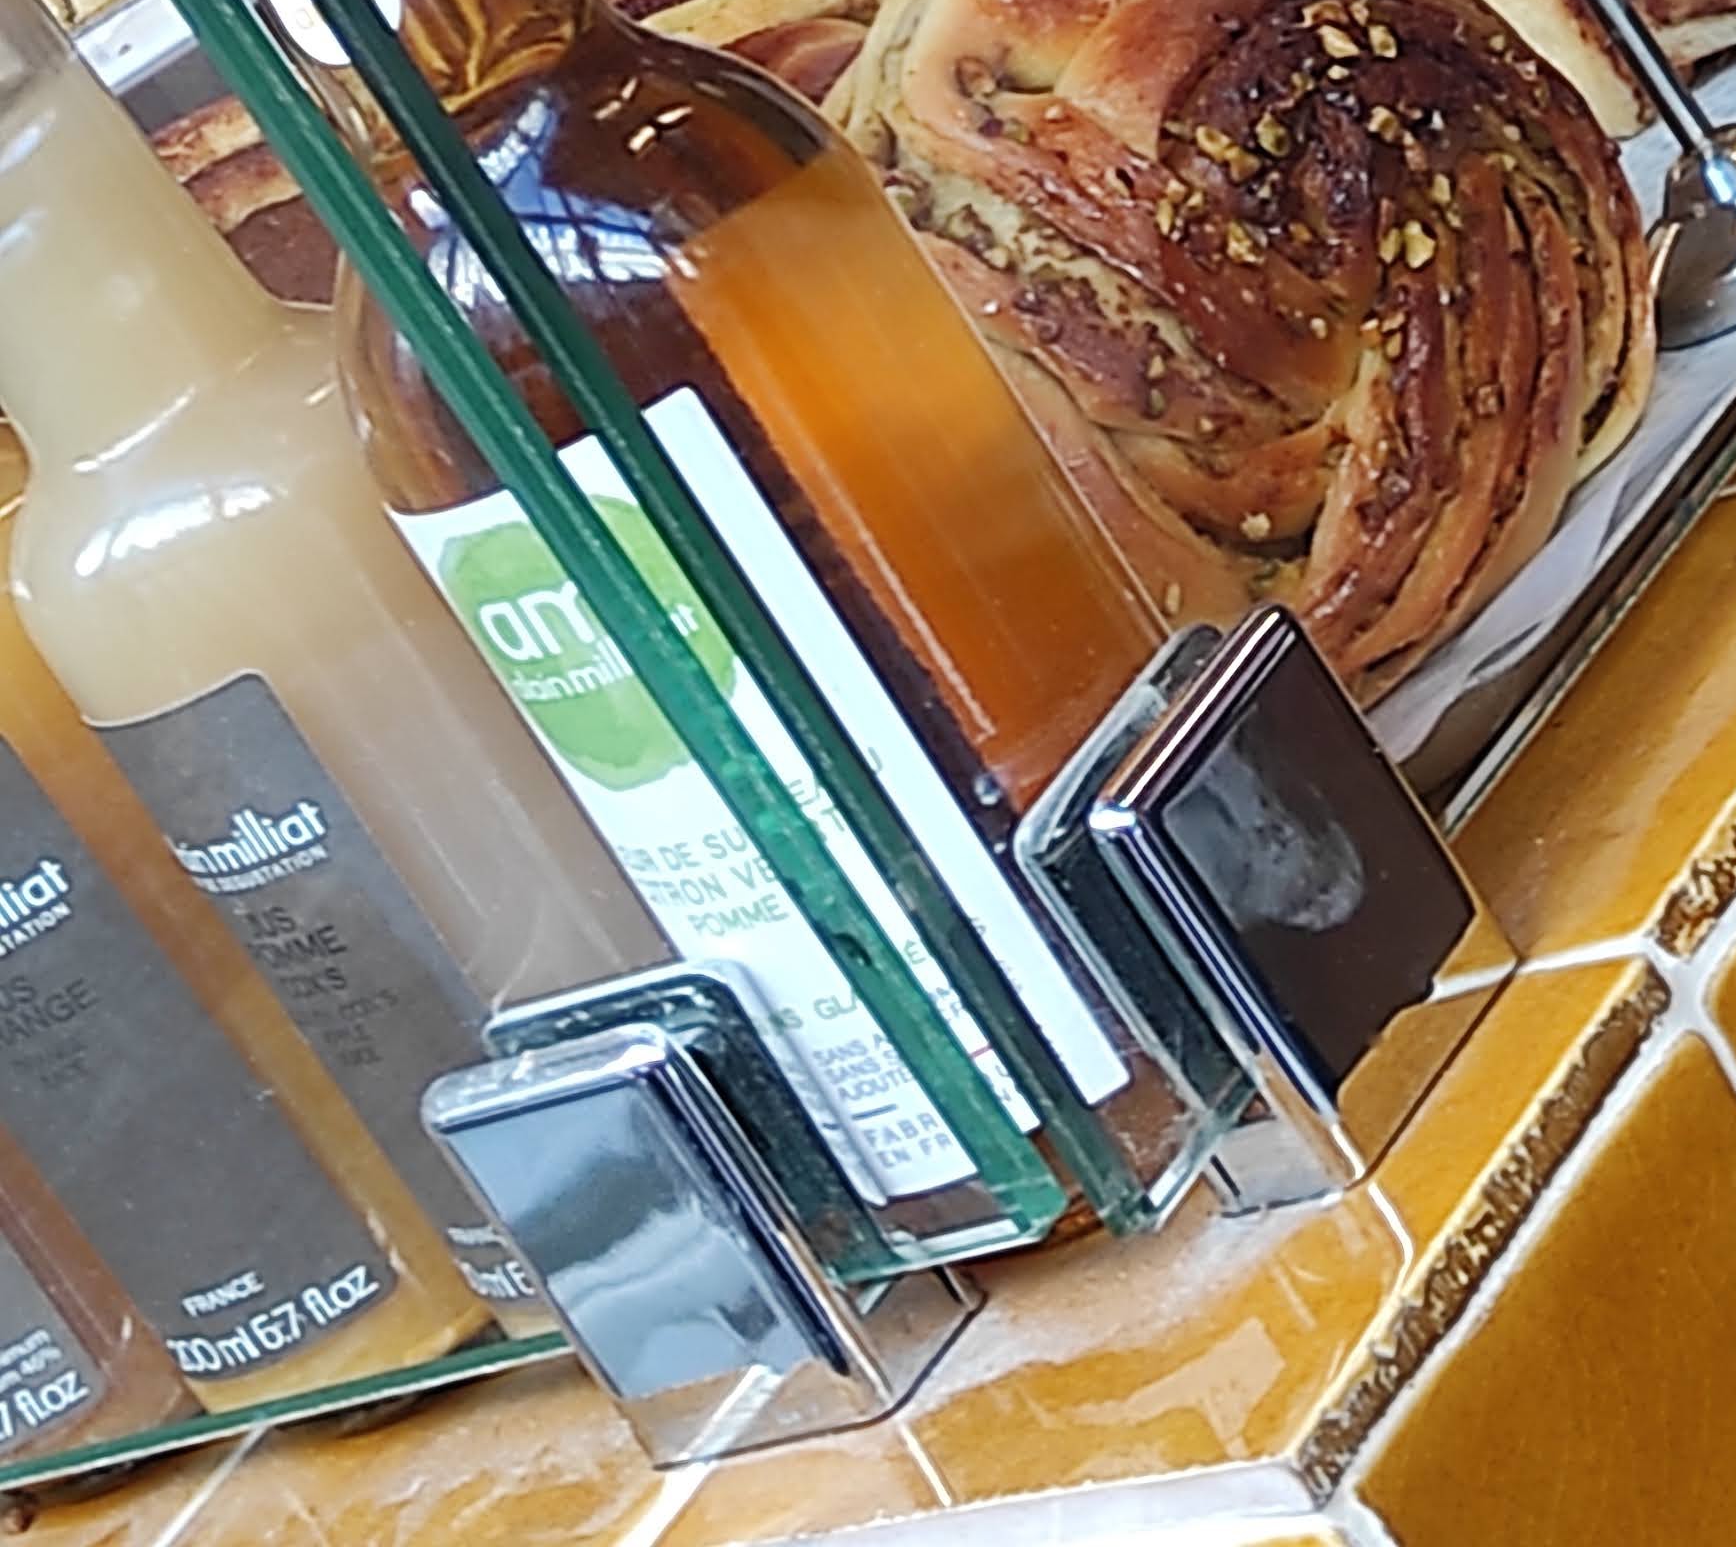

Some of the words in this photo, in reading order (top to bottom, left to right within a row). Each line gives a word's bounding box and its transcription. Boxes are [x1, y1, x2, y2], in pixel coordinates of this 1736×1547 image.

[657, 841, 701, 872] DE
[687, 893, 790, 937] POMME
[0, 976, 101, 1048] ANGE
[181, 1270, 265, 1318] FRANCE
